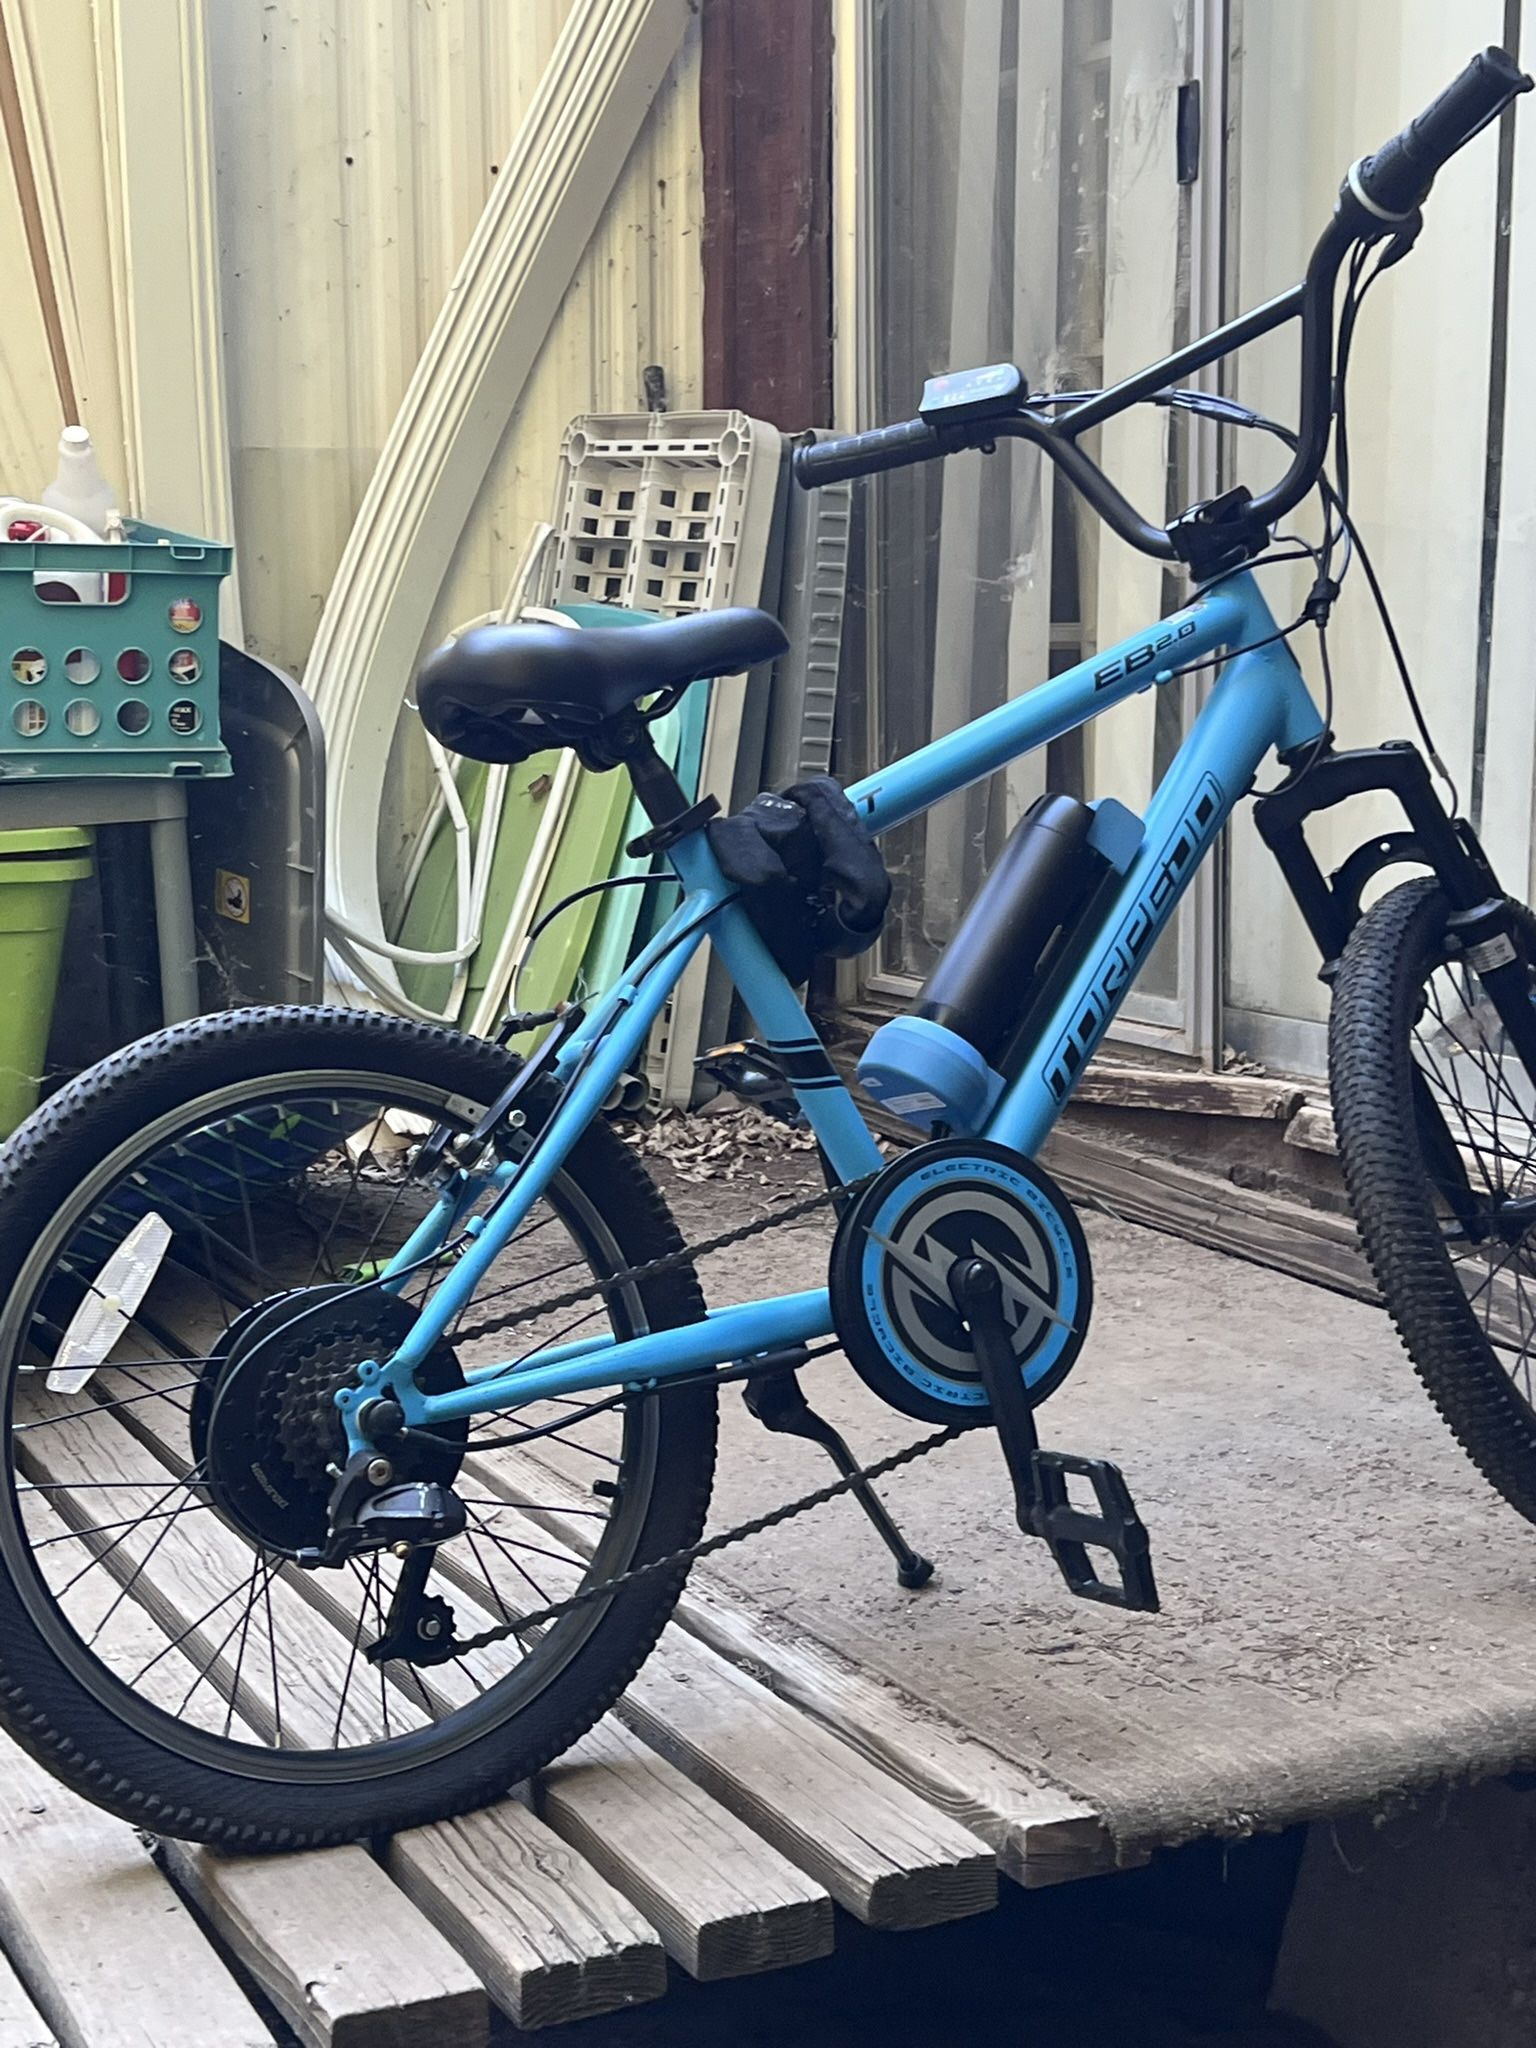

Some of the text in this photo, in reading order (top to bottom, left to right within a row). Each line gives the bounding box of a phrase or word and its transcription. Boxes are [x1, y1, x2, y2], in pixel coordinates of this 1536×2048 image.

[1047, 775, 1222, 1102] TORPEDO
[920, 1163, 1073, 1279] ELECTRIC BICYCLE
[866, 1283, 985, 1401] CTRIC BICYCLE
